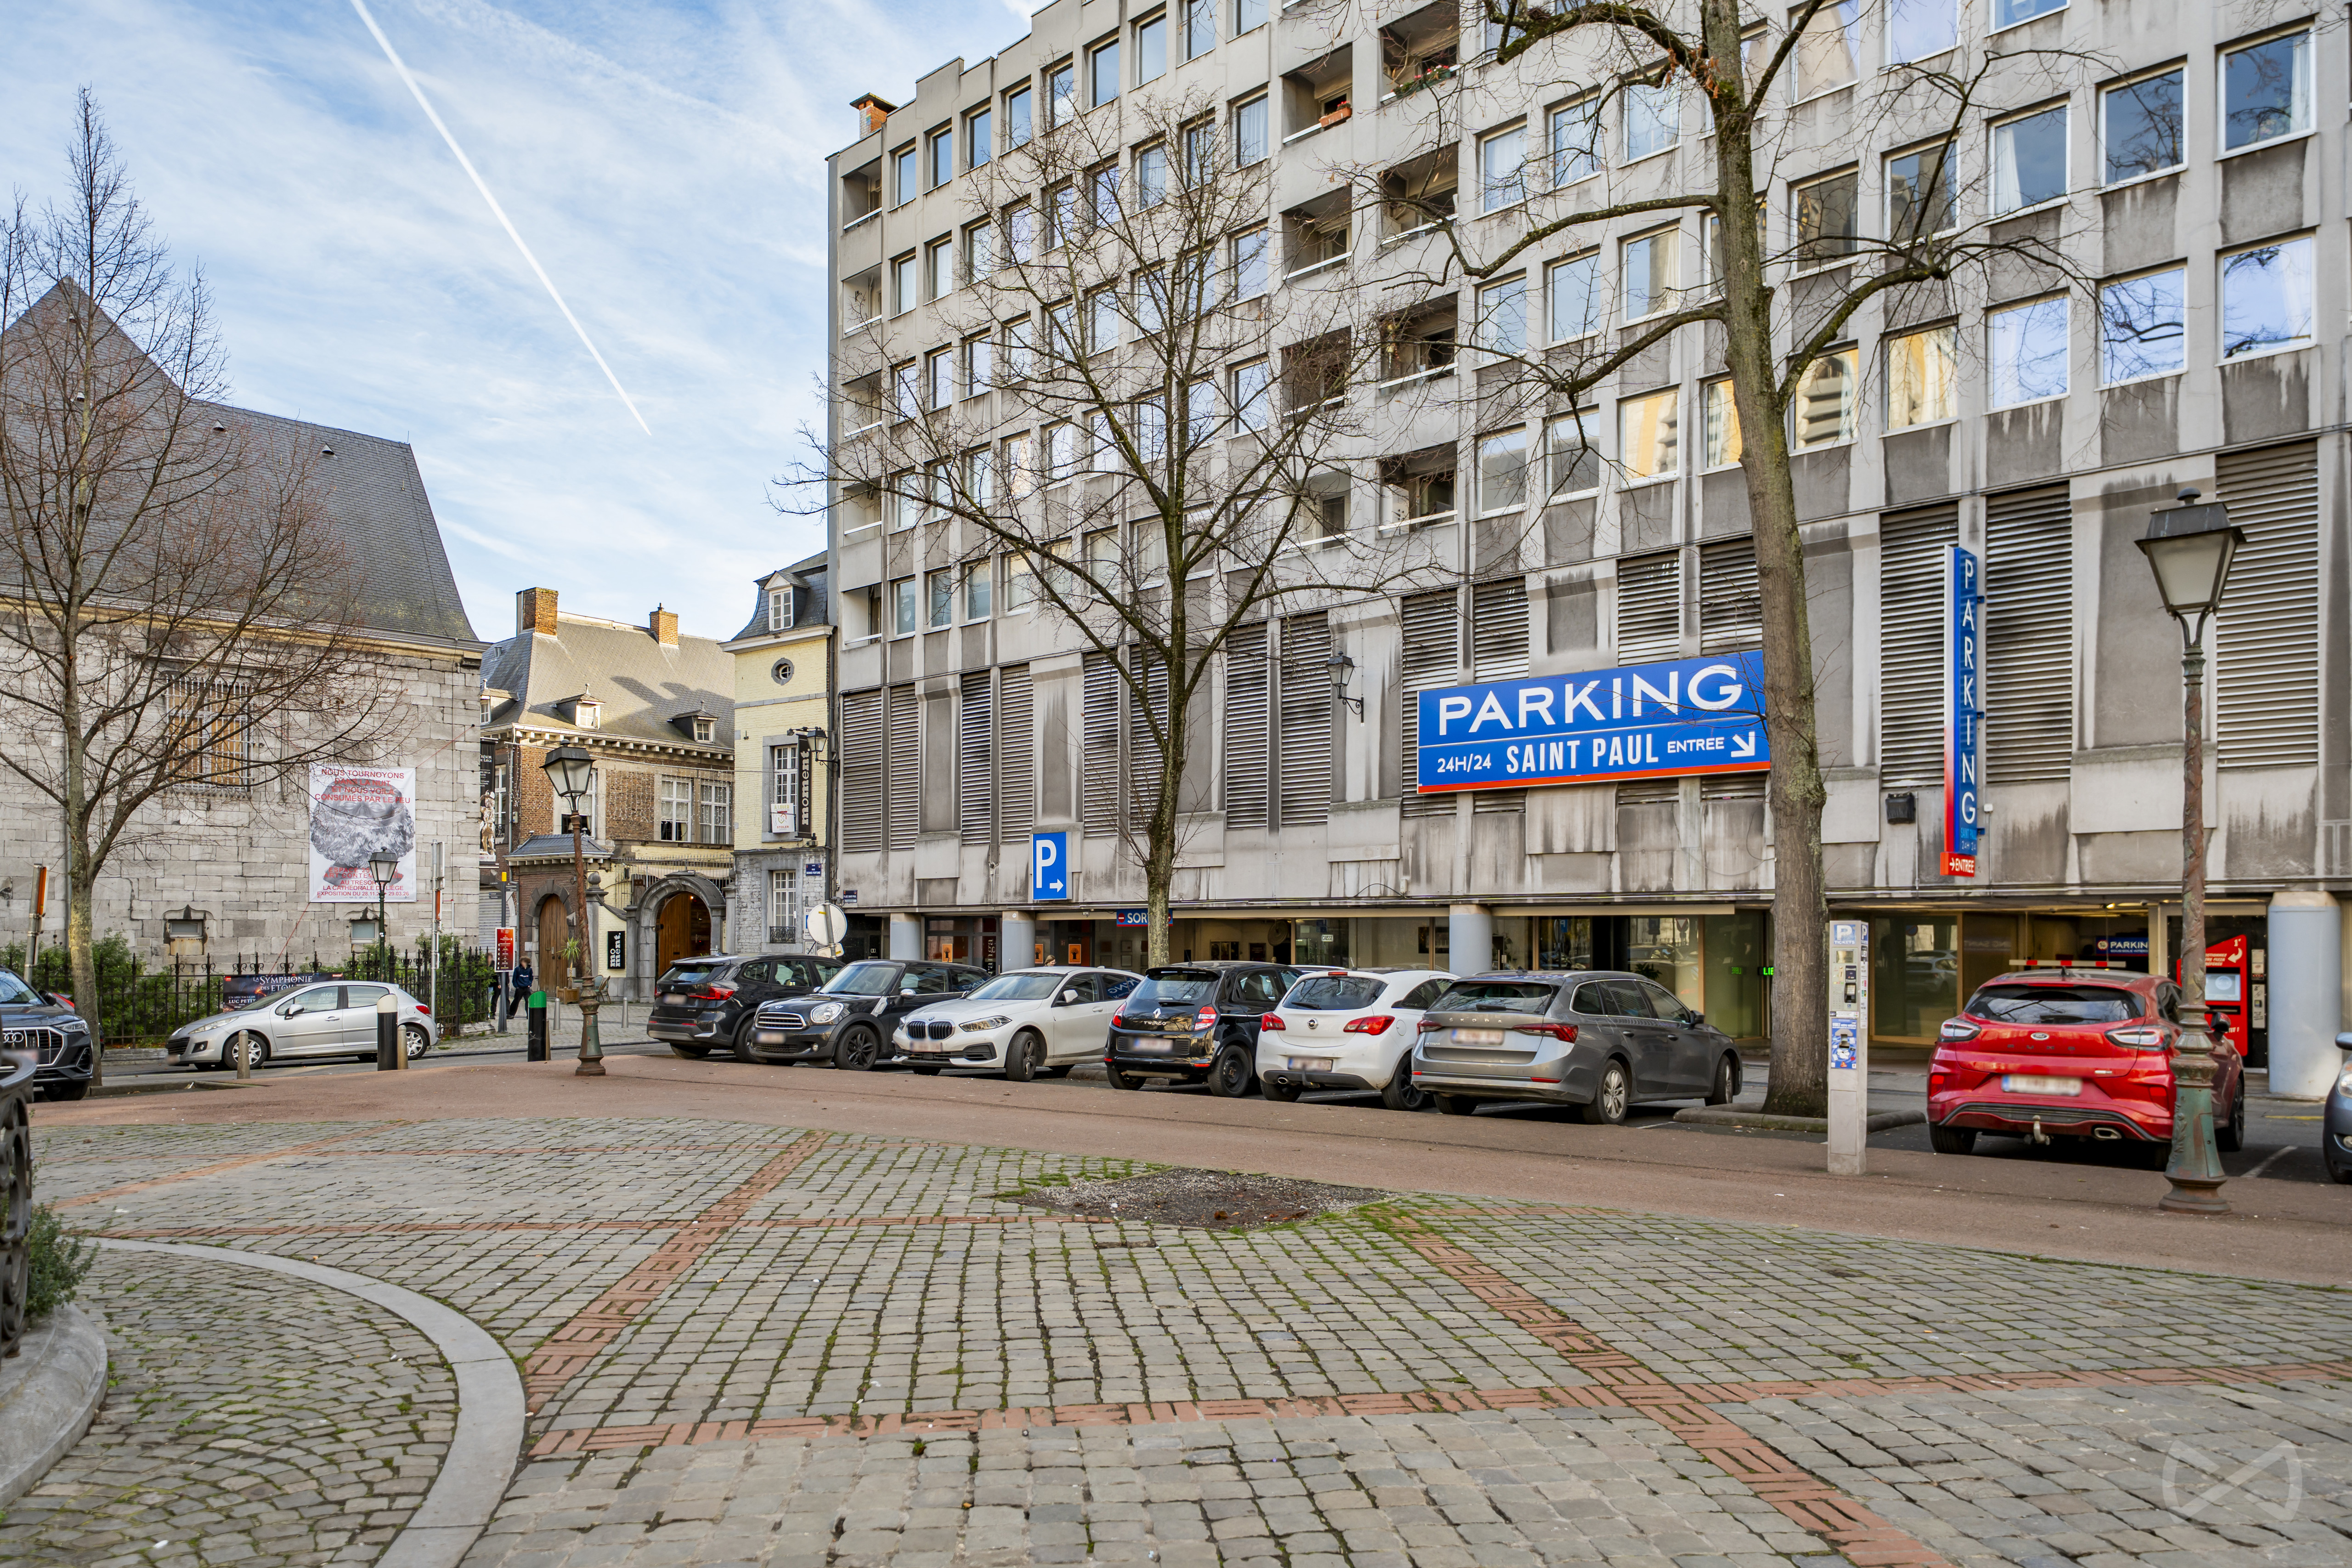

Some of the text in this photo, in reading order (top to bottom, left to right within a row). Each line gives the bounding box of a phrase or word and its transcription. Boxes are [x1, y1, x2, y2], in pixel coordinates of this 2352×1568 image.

[1962, 559, 1975, 824] PARKING
[1439, 664, 1742, 736] PARKING
[1437, 734, 1725, 774] 24H/24 SAINT PAUL ENTREE
[347, 770, 404, 779] TOURNOYONS
[370, 786, 394, 795] VOILÀ
[800, 748, 810, 825] moment.
[1036, 839, 1057, 888] P
[1955, 858, 1974, 873] ENTREE
[1127, 912, 1148, 923] SOR
[1837, 925, 1852, 940] P
[1861, 925, 1867, 940] P
[260, 975, 313, 985] SYMPHONIE
